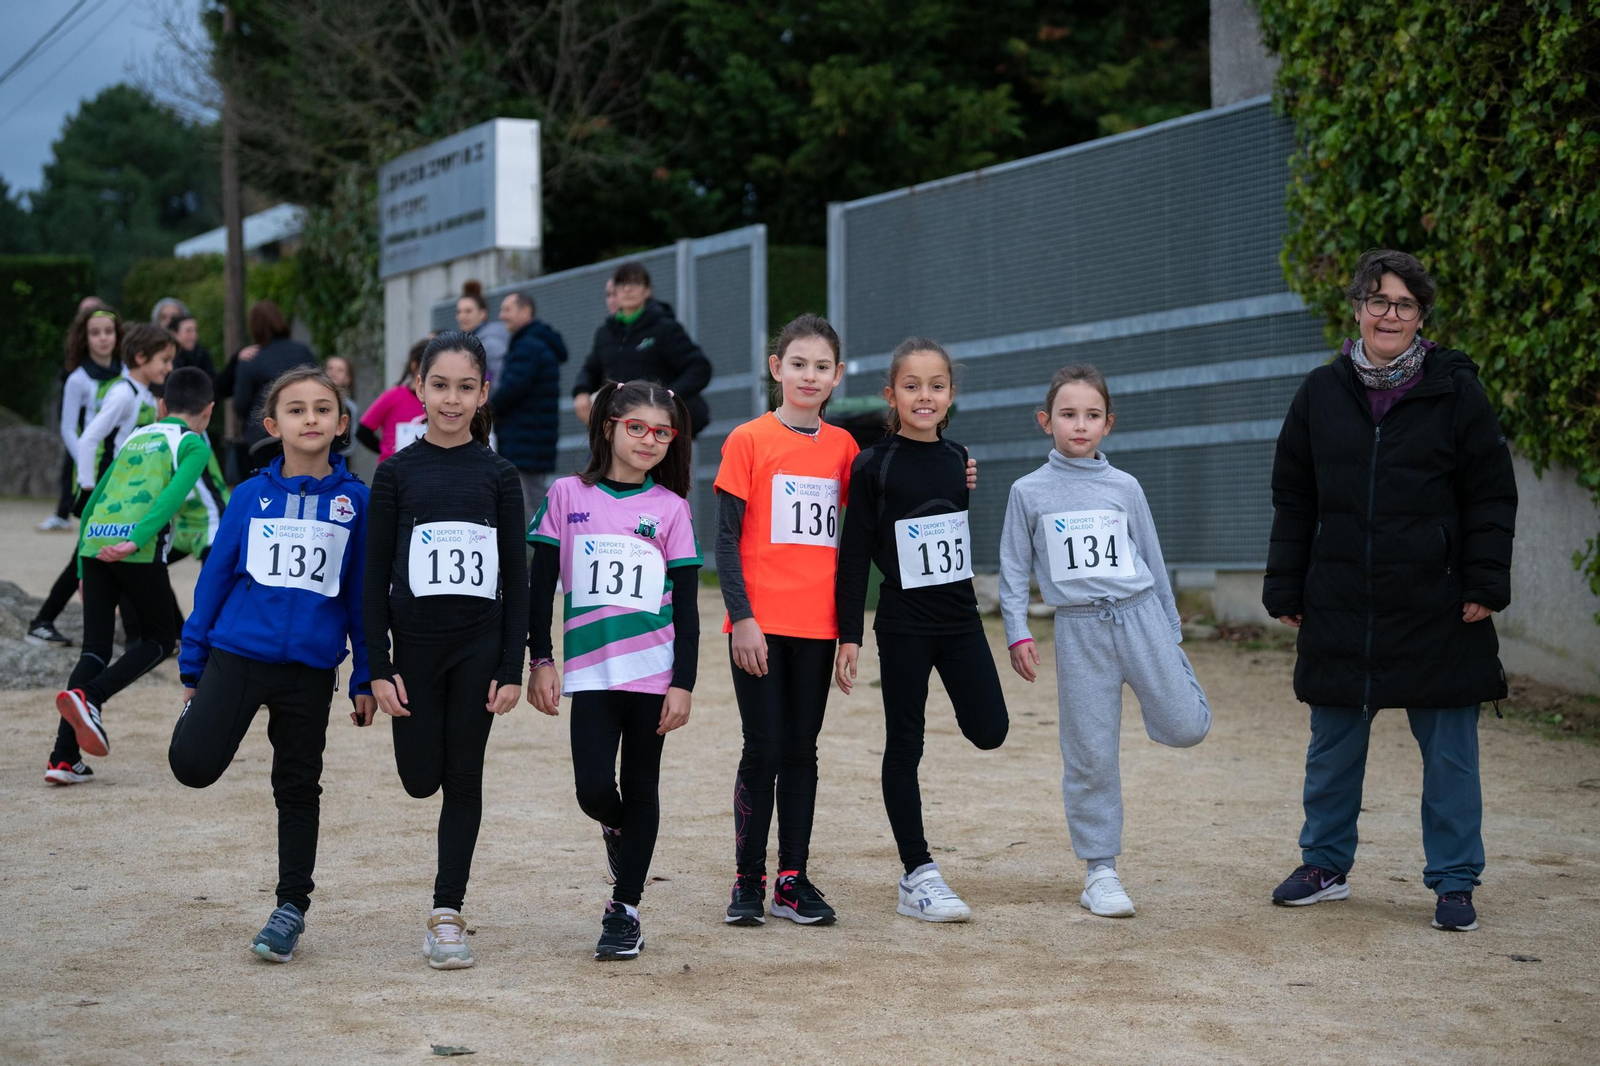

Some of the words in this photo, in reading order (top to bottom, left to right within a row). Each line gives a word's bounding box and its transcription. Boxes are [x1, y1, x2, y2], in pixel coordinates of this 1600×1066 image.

[799, 483, 821, 491] DEPORTE
[791, 501, 836, 538] 136
[1069, 517, 1095, 525] DEPORTE
[279, 525, 307, 533] DEPORTE
[922, 521, 946, 530] DEPORTE
[923, 529, 946, 537] GALEGO
[598, 541, 626, 549] DEPORTE
[598, 548, 623, 556] GALEGO
[917, 537, 964, 576] 135
[1063, 534, 1119, 570] 134
[267, 542, 327, 583] 132
[427, 548, 484, 587] 133
[587, 559, 643, 599] 131
